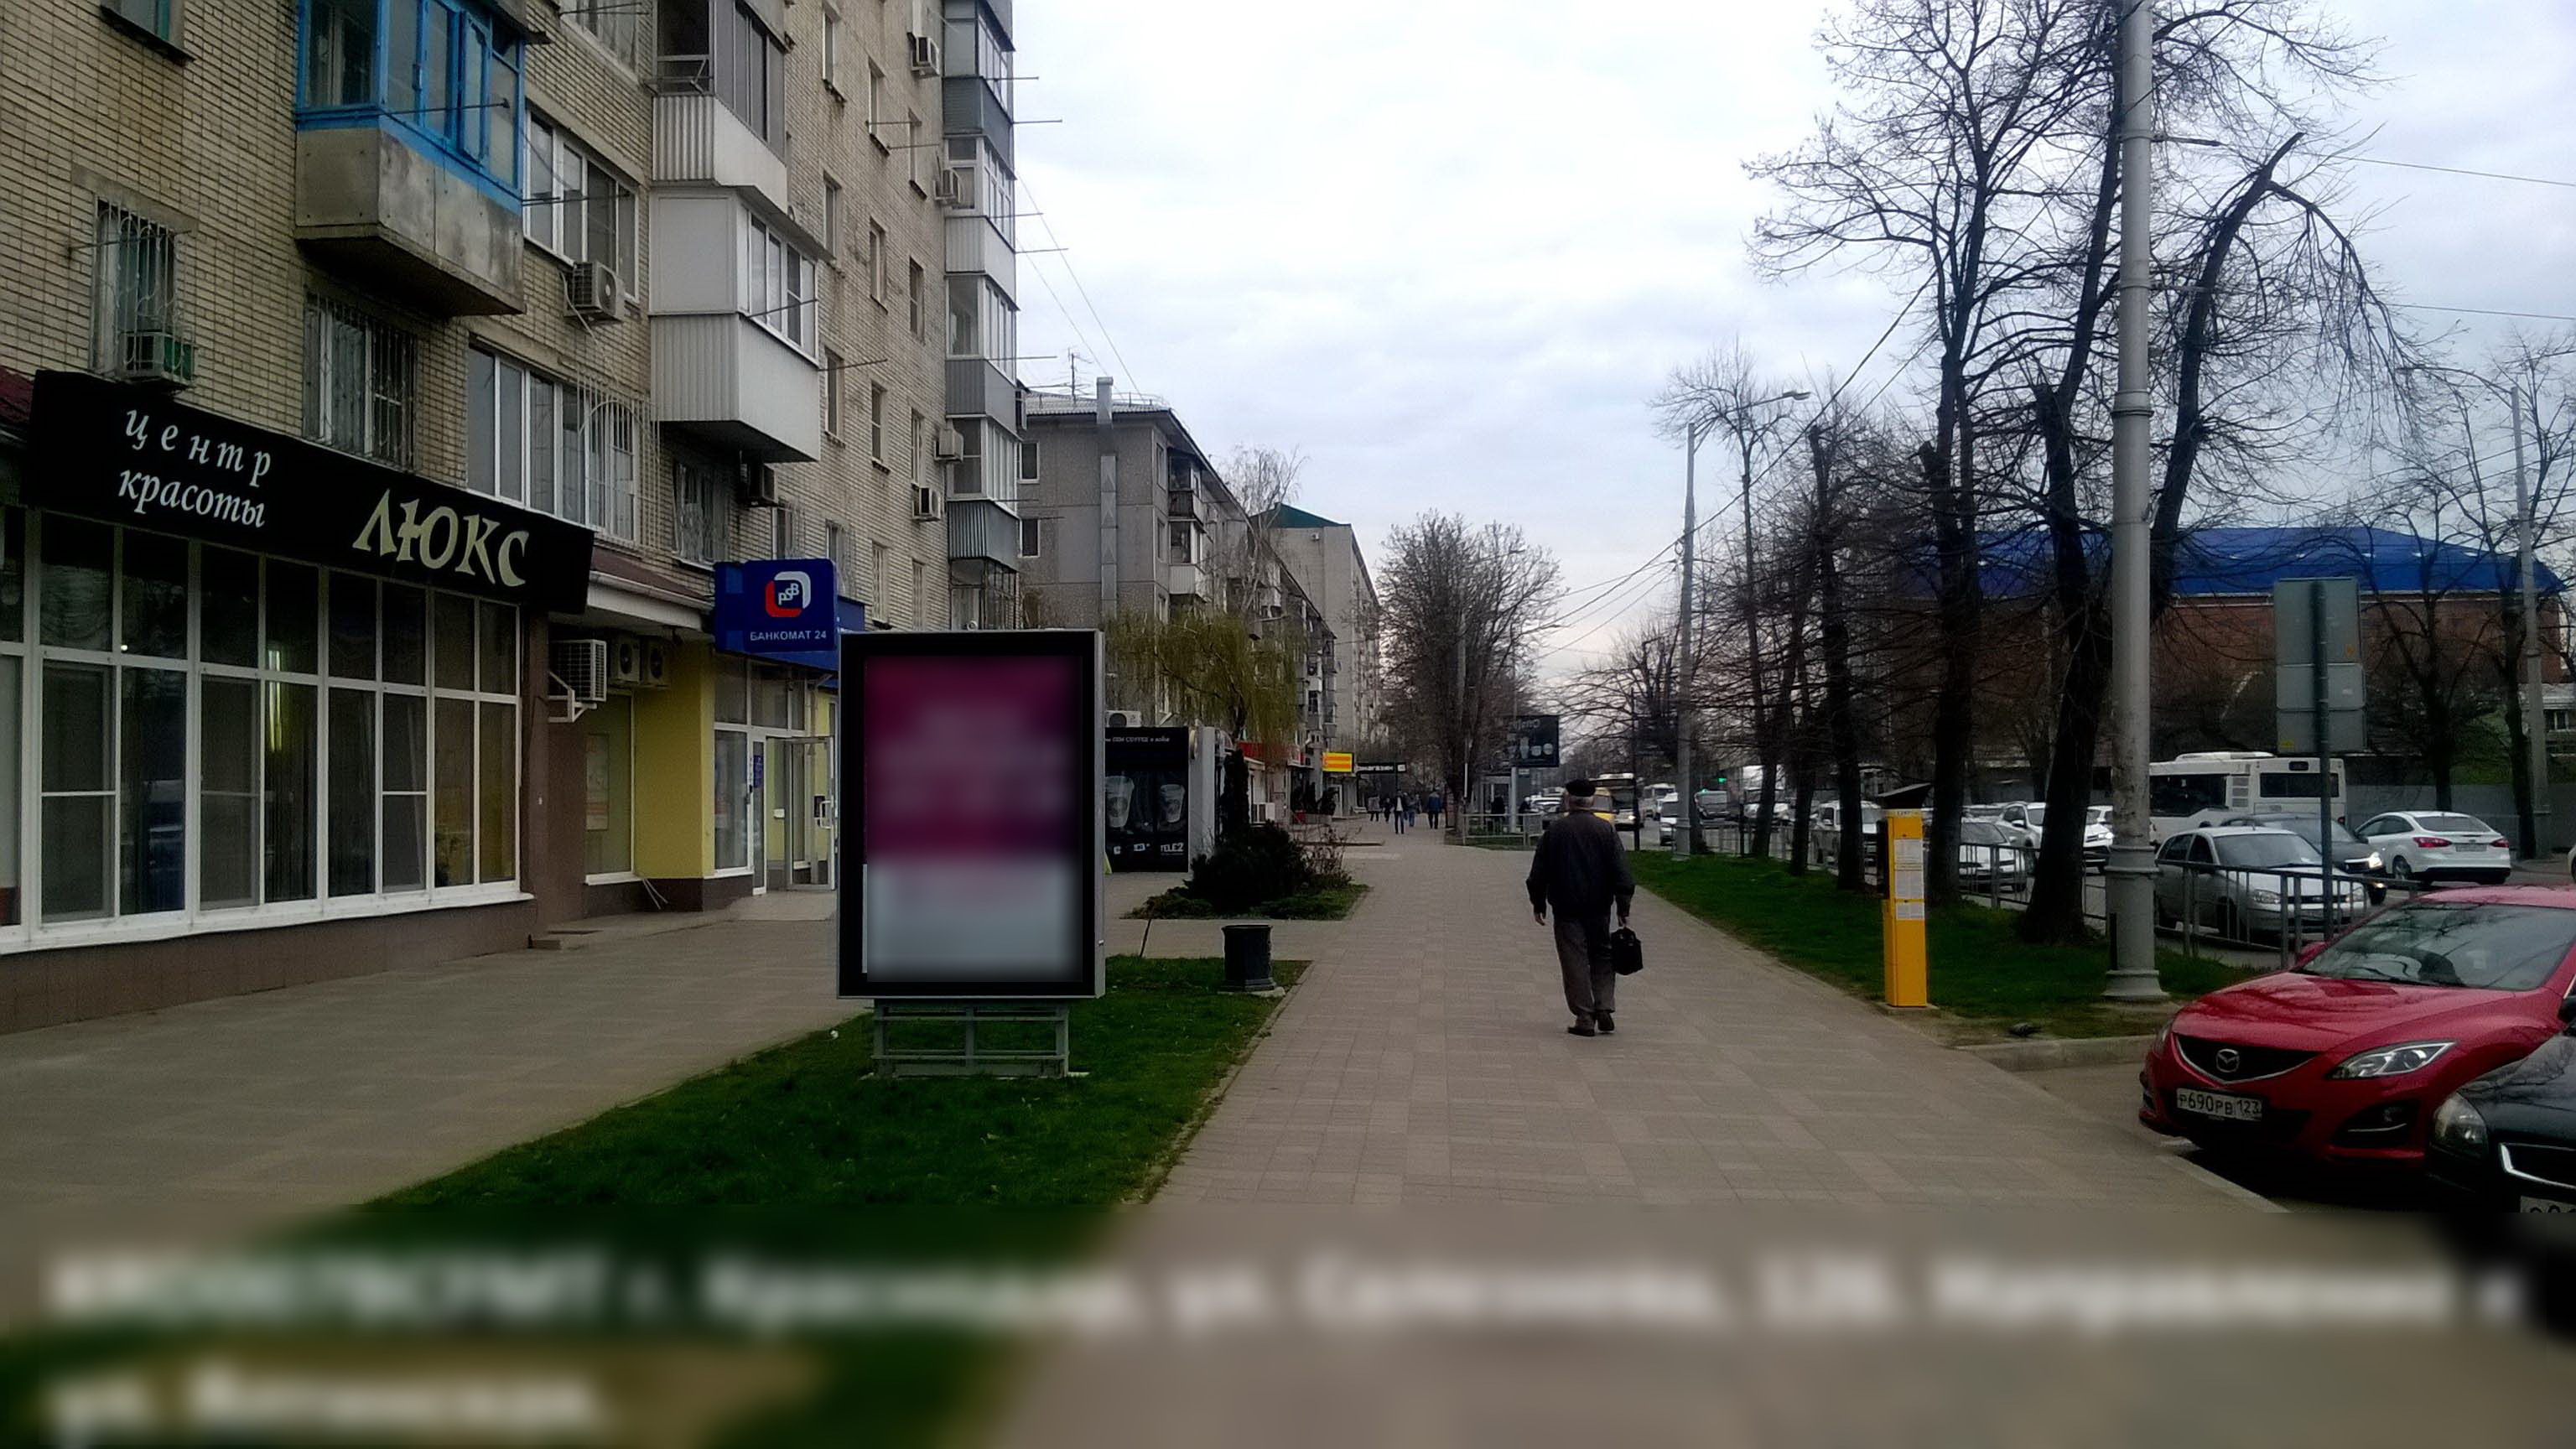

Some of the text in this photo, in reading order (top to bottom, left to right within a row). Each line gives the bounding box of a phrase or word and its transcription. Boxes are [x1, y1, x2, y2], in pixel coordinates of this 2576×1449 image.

[125, 408, 272, 487] центр
[117, 467, 267, 529] красоты
[351, 488, 531, 588] ЛЮКС
[750, 630, 827, 641] БАНКОМАТ 24
[1160, 842, 1185, 854] TELE2
